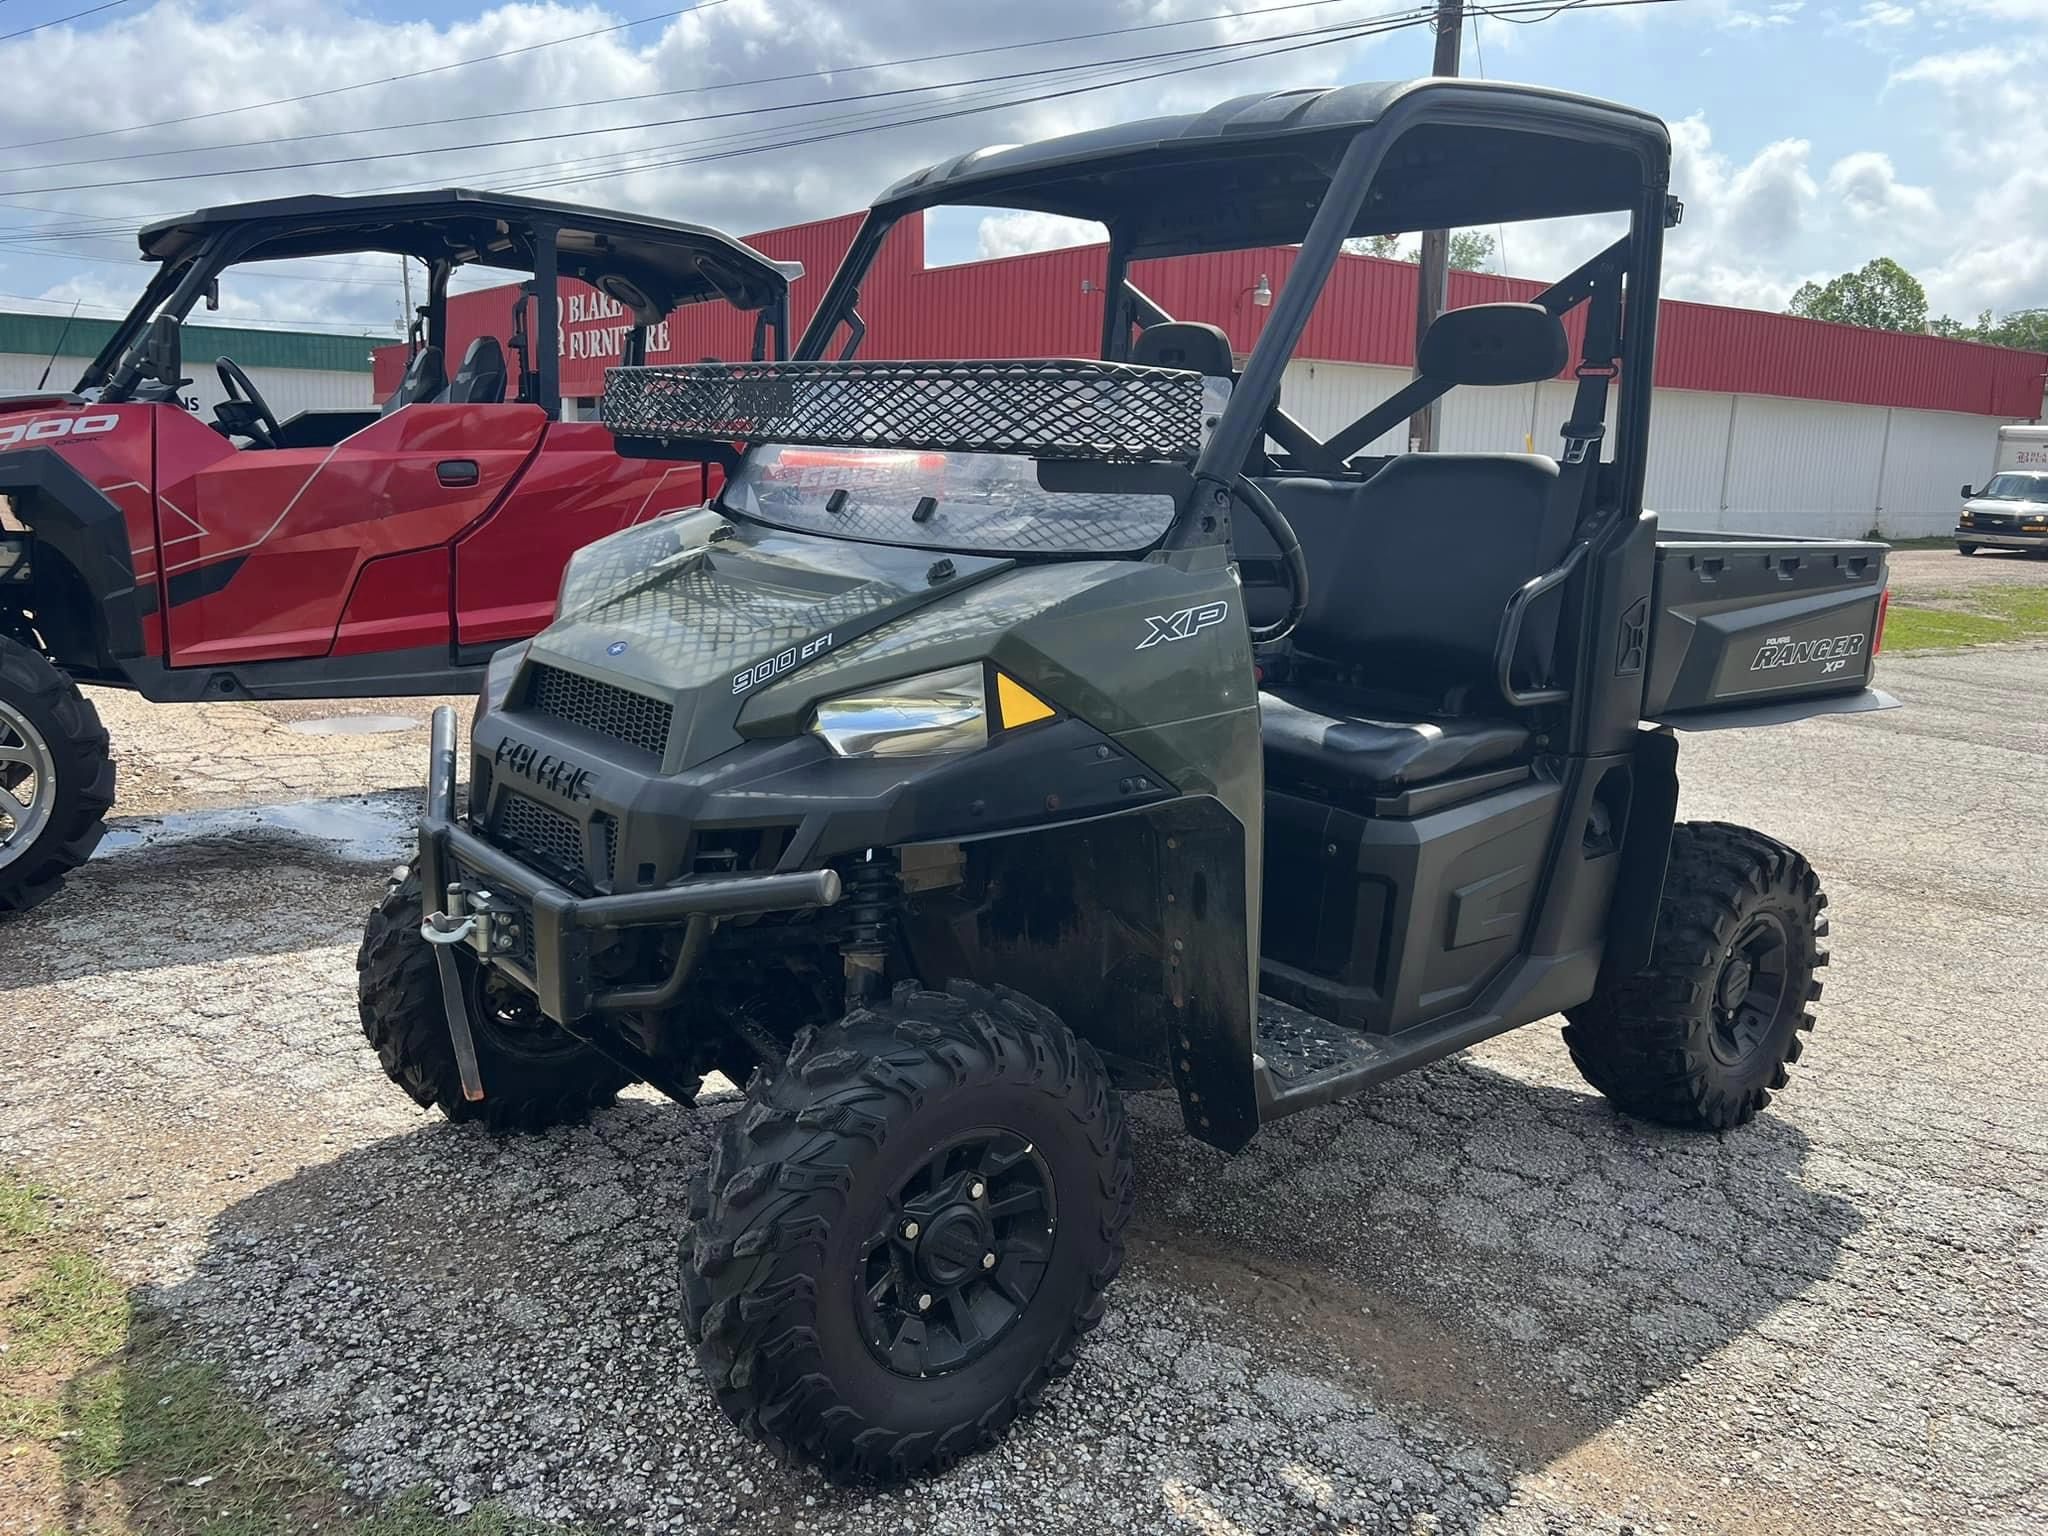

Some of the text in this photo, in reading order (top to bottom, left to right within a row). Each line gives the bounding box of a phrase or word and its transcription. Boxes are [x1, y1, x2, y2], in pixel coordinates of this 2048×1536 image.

[1135, 601, 1228, 650] XP
[732, 632, 833, 694] 900 EFI
[1750, 633, 1865, 671] RANGER
[1820, 660, 1846, 674] XP
[495, 736, 600, 803] POLARIS
